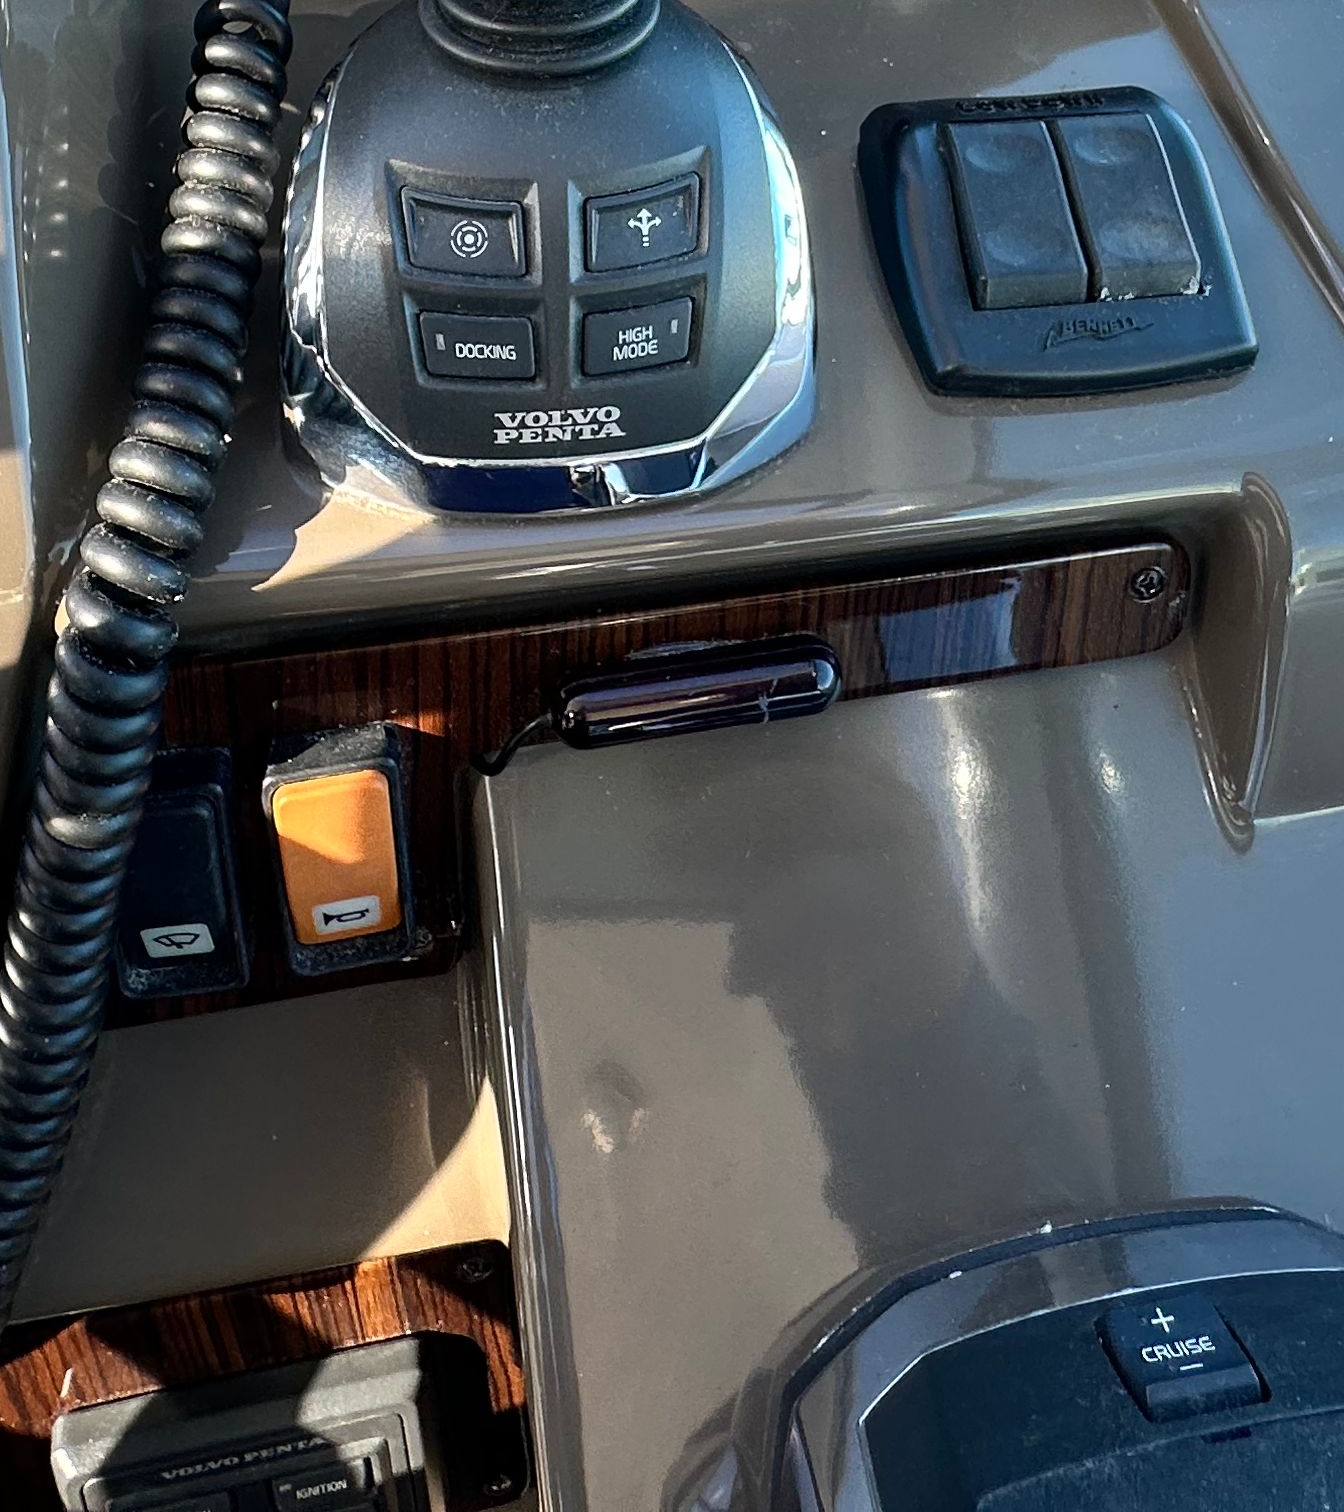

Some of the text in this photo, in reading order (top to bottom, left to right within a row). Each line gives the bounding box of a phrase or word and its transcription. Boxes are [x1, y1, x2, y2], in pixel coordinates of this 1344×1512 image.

[618, 325, 653, 345] HIGH
[455, 342, 517, 361] DOCKING
[612, 339, 659, 361] MODE
[494, 406, 622, 428] VOLVO
[493, 423, 626, 445] PENTA
[1141, 1335, 1216, 1363] CRUISE
[160, 1436, 326, 1480] VOLVO PENTA
[296, 1479, 348, 1500] IGNITION
